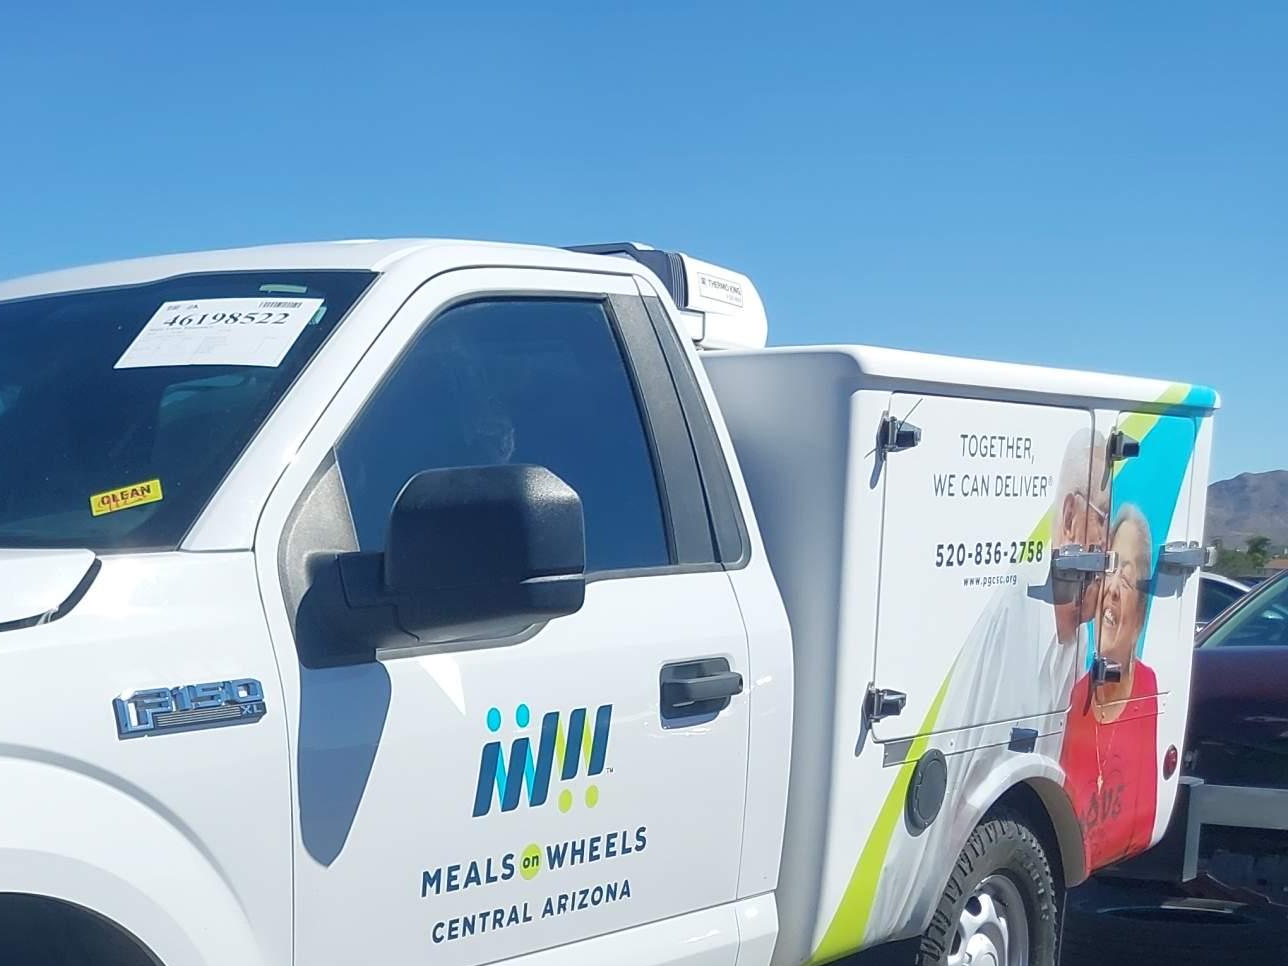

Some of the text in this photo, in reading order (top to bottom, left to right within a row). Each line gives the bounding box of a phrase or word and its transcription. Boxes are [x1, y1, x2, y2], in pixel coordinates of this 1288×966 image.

[163, 312, 290, 327] 46198522
[960, 434, 1035, 464] TOGETHER,
[100, 484, 152, 506] CLEAN
[933, 473, 956, 497] WE
[961, 474, 990, 497] CAN
[935, 540, 1044, 567] 520-836-2758
[963, 574, 1017, 587] www.pgcsc.org
[240, 704, 263, 715] XL
[421, 826, 647, 898] MEALS on WHEELS
[432, 879, 631, 944] CENTRAL ARIZONA
